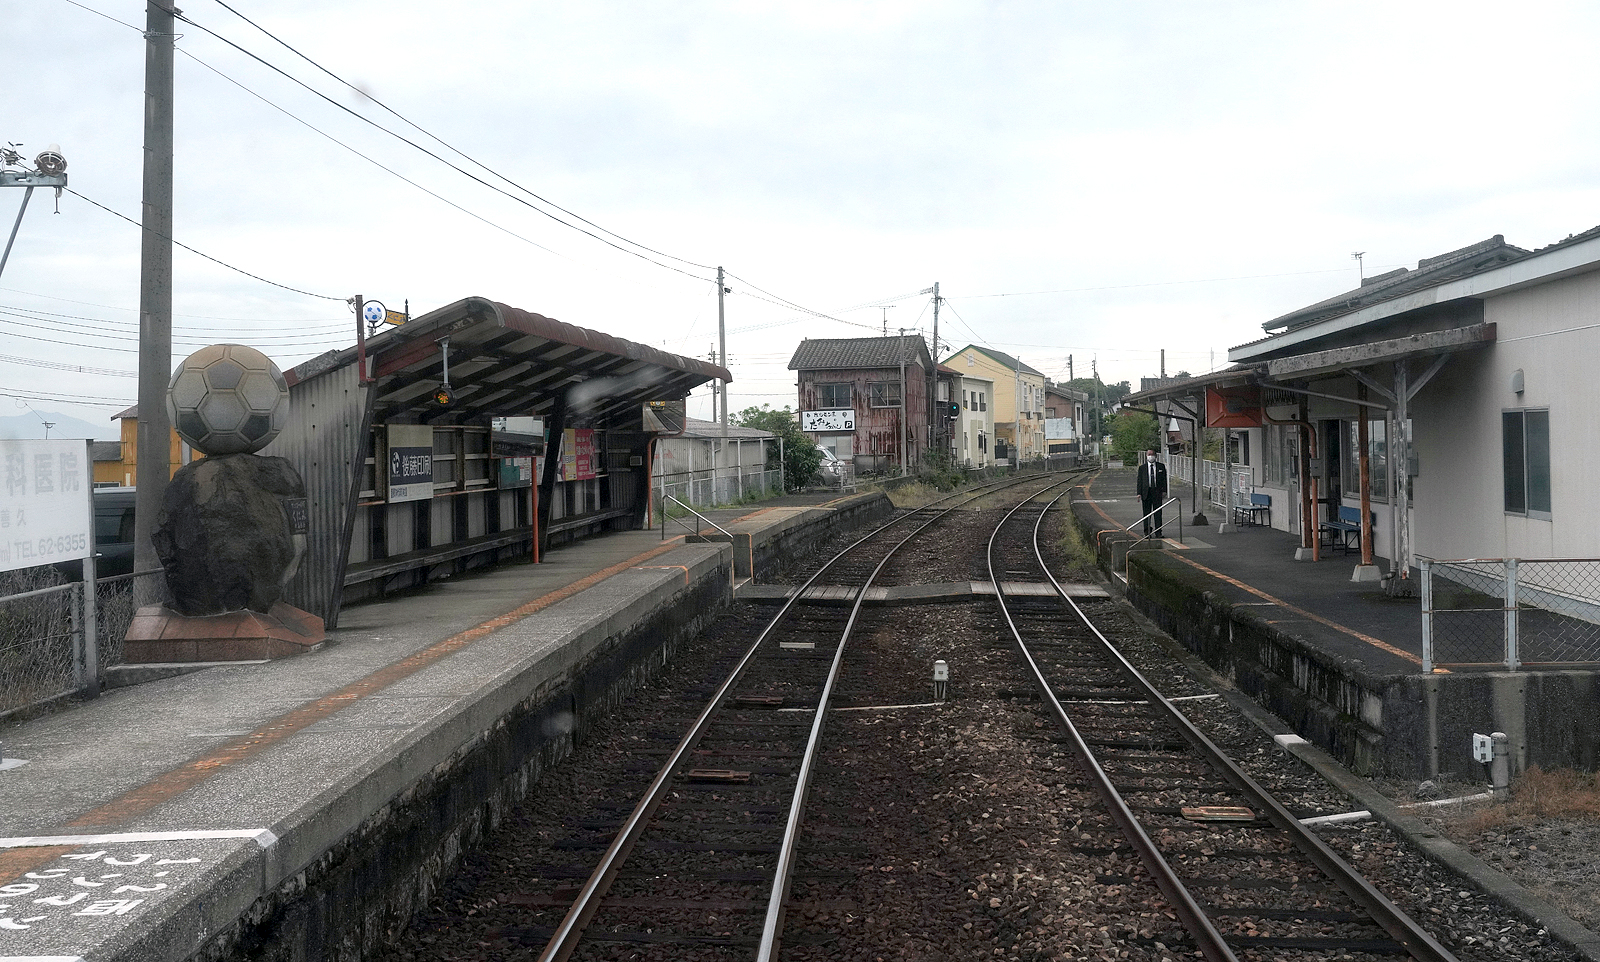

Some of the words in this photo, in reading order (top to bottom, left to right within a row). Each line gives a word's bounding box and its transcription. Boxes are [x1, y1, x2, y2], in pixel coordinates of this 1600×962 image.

[5, 452, 80, 497] 科医院
[402, 455, 431, 477] 後藤印刷
